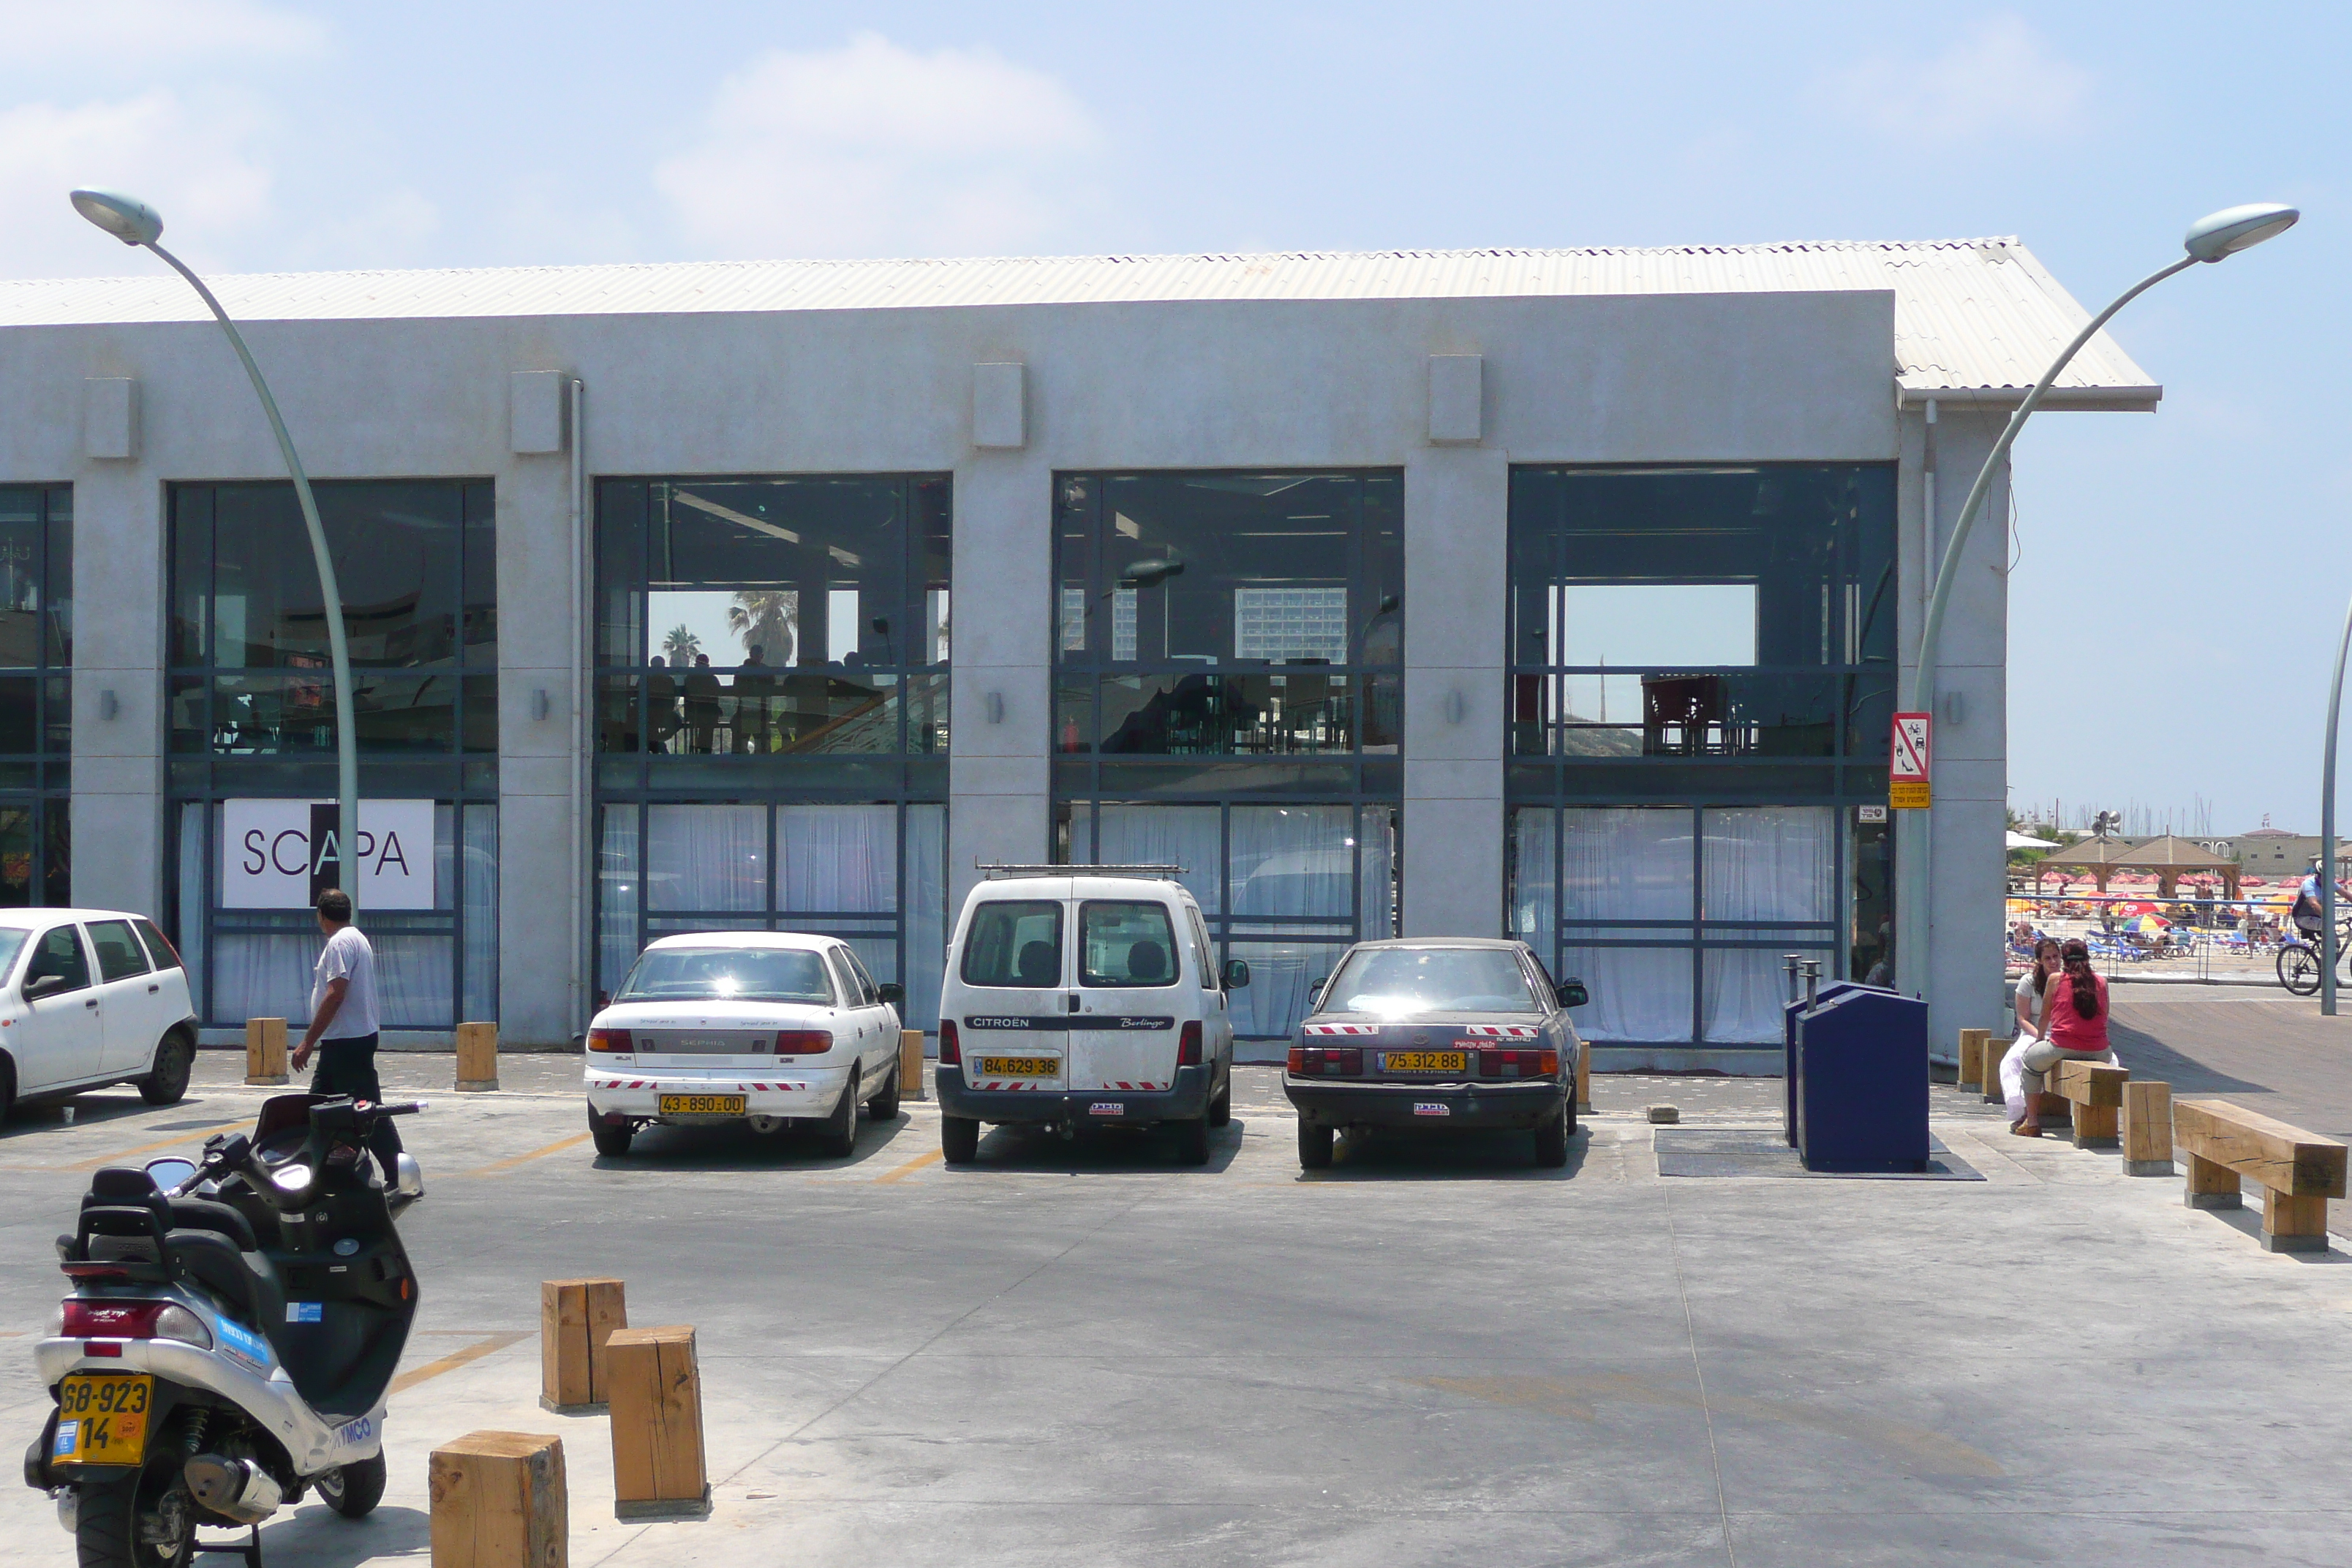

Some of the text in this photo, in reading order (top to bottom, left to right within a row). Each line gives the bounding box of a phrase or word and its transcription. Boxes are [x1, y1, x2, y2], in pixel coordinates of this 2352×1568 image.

[243, 829, 410, 875] SCAPA
[973, 1017, 1165, 1028] CITROËN Berlingo
[61, 1382, 148, 1414] 68-923
[83, 1417, 110, 1450] 14
